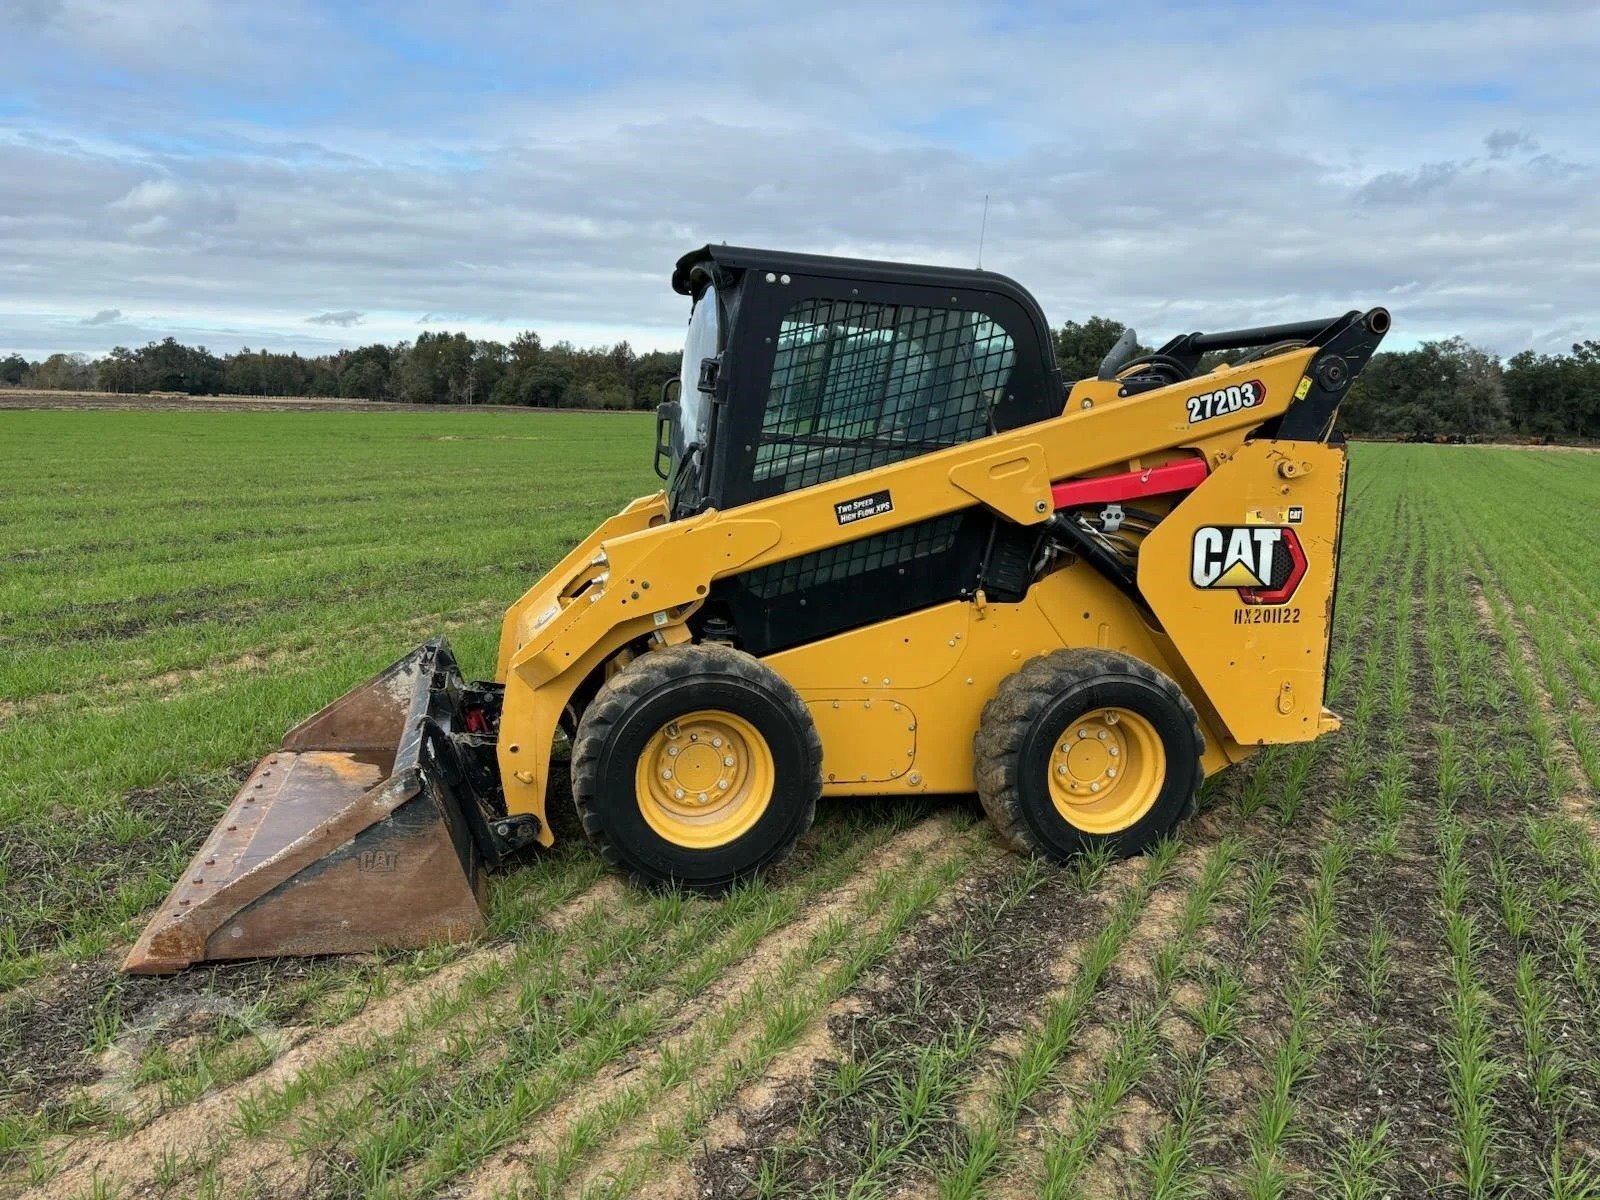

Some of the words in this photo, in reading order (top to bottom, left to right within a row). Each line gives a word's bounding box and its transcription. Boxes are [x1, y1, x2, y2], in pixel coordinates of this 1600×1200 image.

[1187, 383, 1256, 423] 272D3
[837, 504, 852, 514] TWO
[853, 498, 873, 510] SPEED
[840, 512, 856, 523] HIGH
[857, 507, 875, 518] FLOW
[876, 501, 890, 513] XPS
[1289, 510, 1302, 520] CAT
[1192, 527, 1281, 587] CAT
[360, 849, 399, 872] CAT
